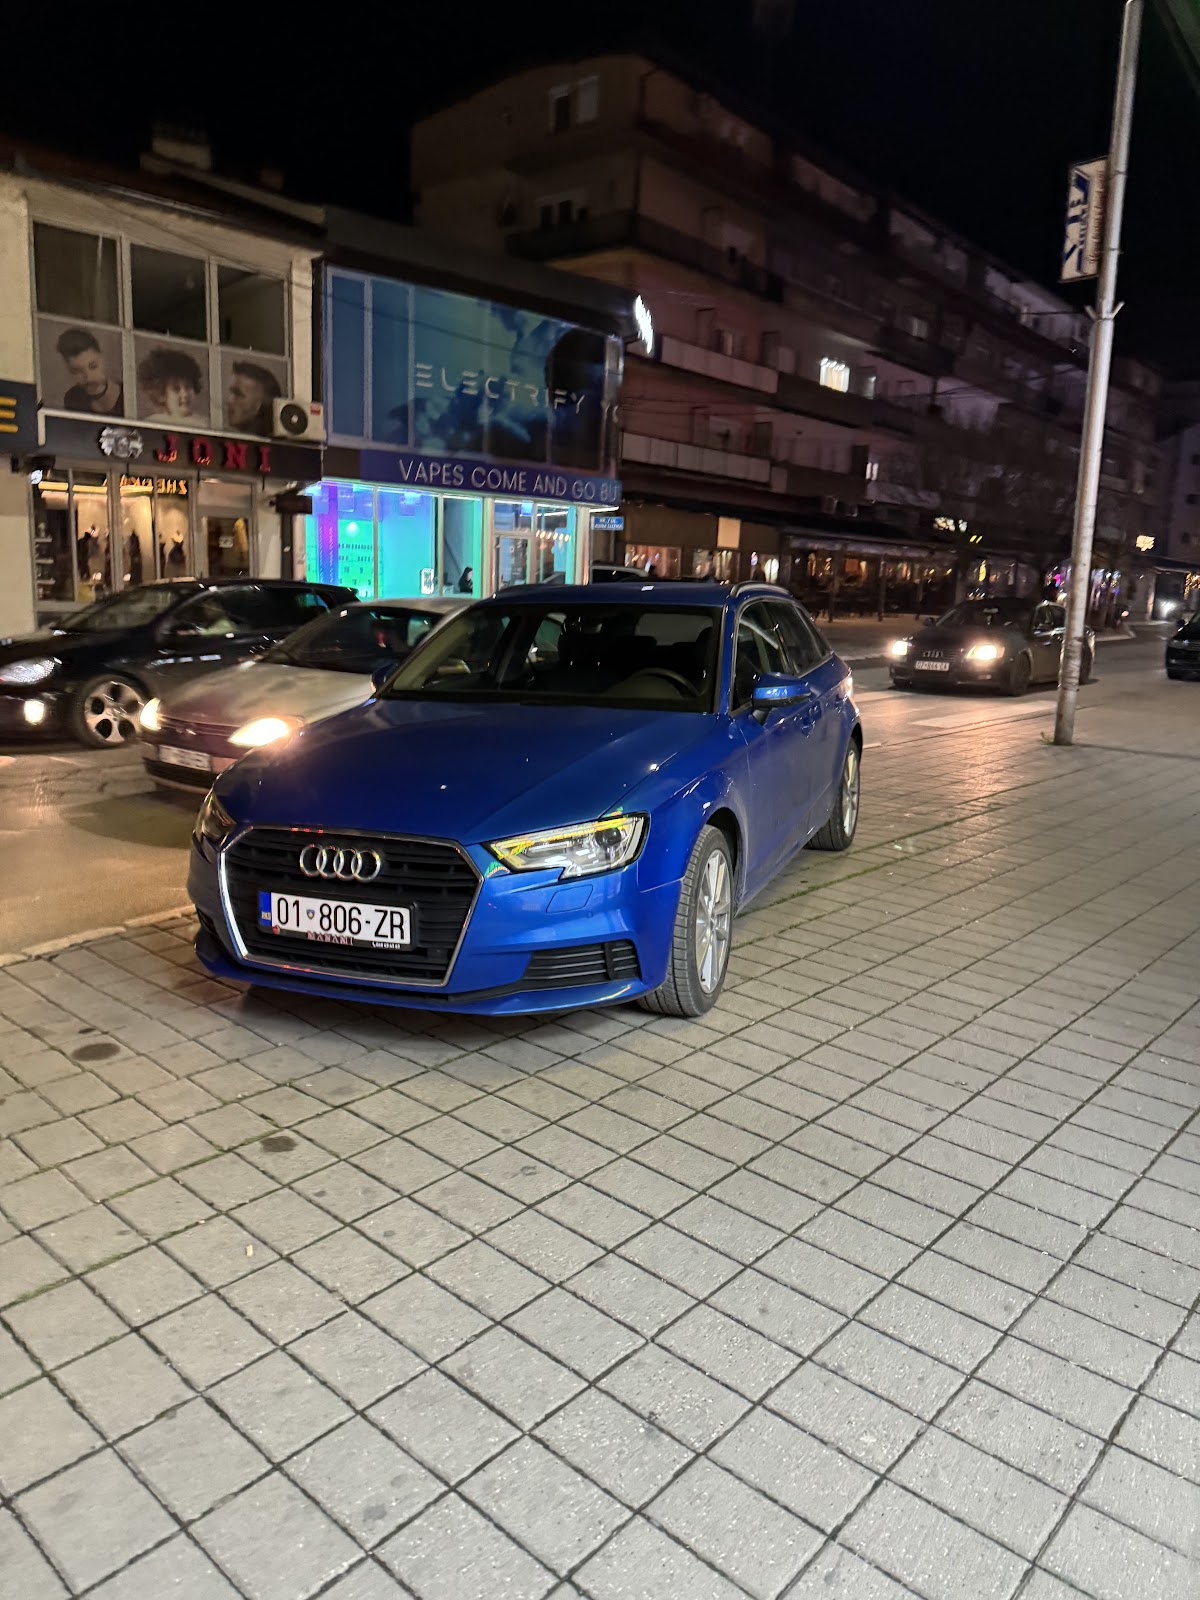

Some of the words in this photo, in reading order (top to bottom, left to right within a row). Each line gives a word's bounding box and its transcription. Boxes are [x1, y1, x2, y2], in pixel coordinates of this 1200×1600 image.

[416, 363, 586, 414] ELECTRIFY
[158, 433, 272, 472] JONI
[399, 459, 464, 486] VAPES
[471, 466, 527, 492] COME
[533, 474, 567, 497] AND
[572, 480, 596, 500] GO
[277, 897, 300, 928] 01
[319, 903, 405, 940] 806-ZR
